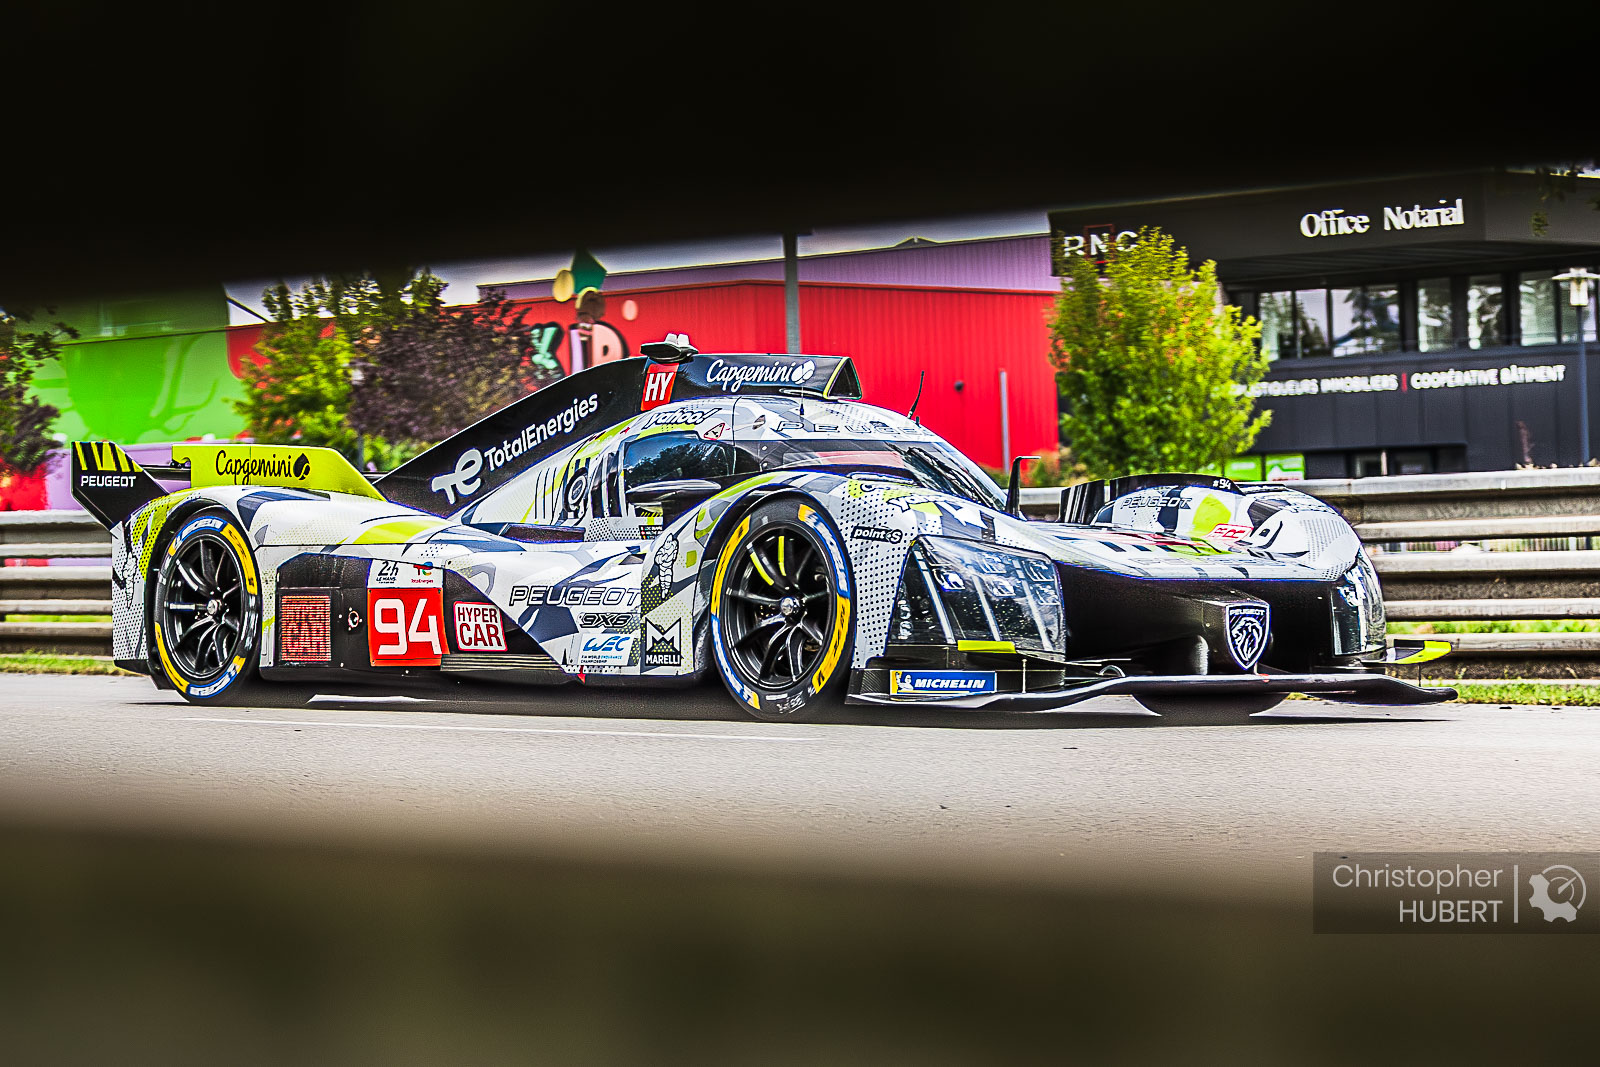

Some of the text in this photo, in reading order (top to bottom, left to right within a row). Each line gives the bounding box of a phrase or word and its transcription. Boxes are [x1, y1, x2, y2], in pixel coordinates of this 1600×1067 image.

[1300, 198, 1464, 238] Office Notarial
[706, 359, 795, 393] Capgemini
[1410, 368, 1499, 390] COOPÉRATIVE
[1500, 364, 1566, 385] BÂTIMENT
[645, 371, 674, 402] HY
[484, 393, 599, 472] TotalEnergies
[215, 449, 293, 486] Capgemini
[80, 474, 137, 488] PEUGEOT
[1212, 478, 1232, 490] #94
[1120, 495, 1193, 510] PEUGEOT
[509, 585, 641, 607] PEUGEOT
[457, 606, 499, 624] HYPER
[580, 613, 634, 629] 9X8
[1229, 608, 1266, 616] PEUGEOT
[374, 598, 443, 656] 94
[459, 622, 503, 647] CAR
[582, 635, 631, 652] WEC
[646, 655, 682, 666] MARELLI
[914, 678, 987, 689] MICHELIN
